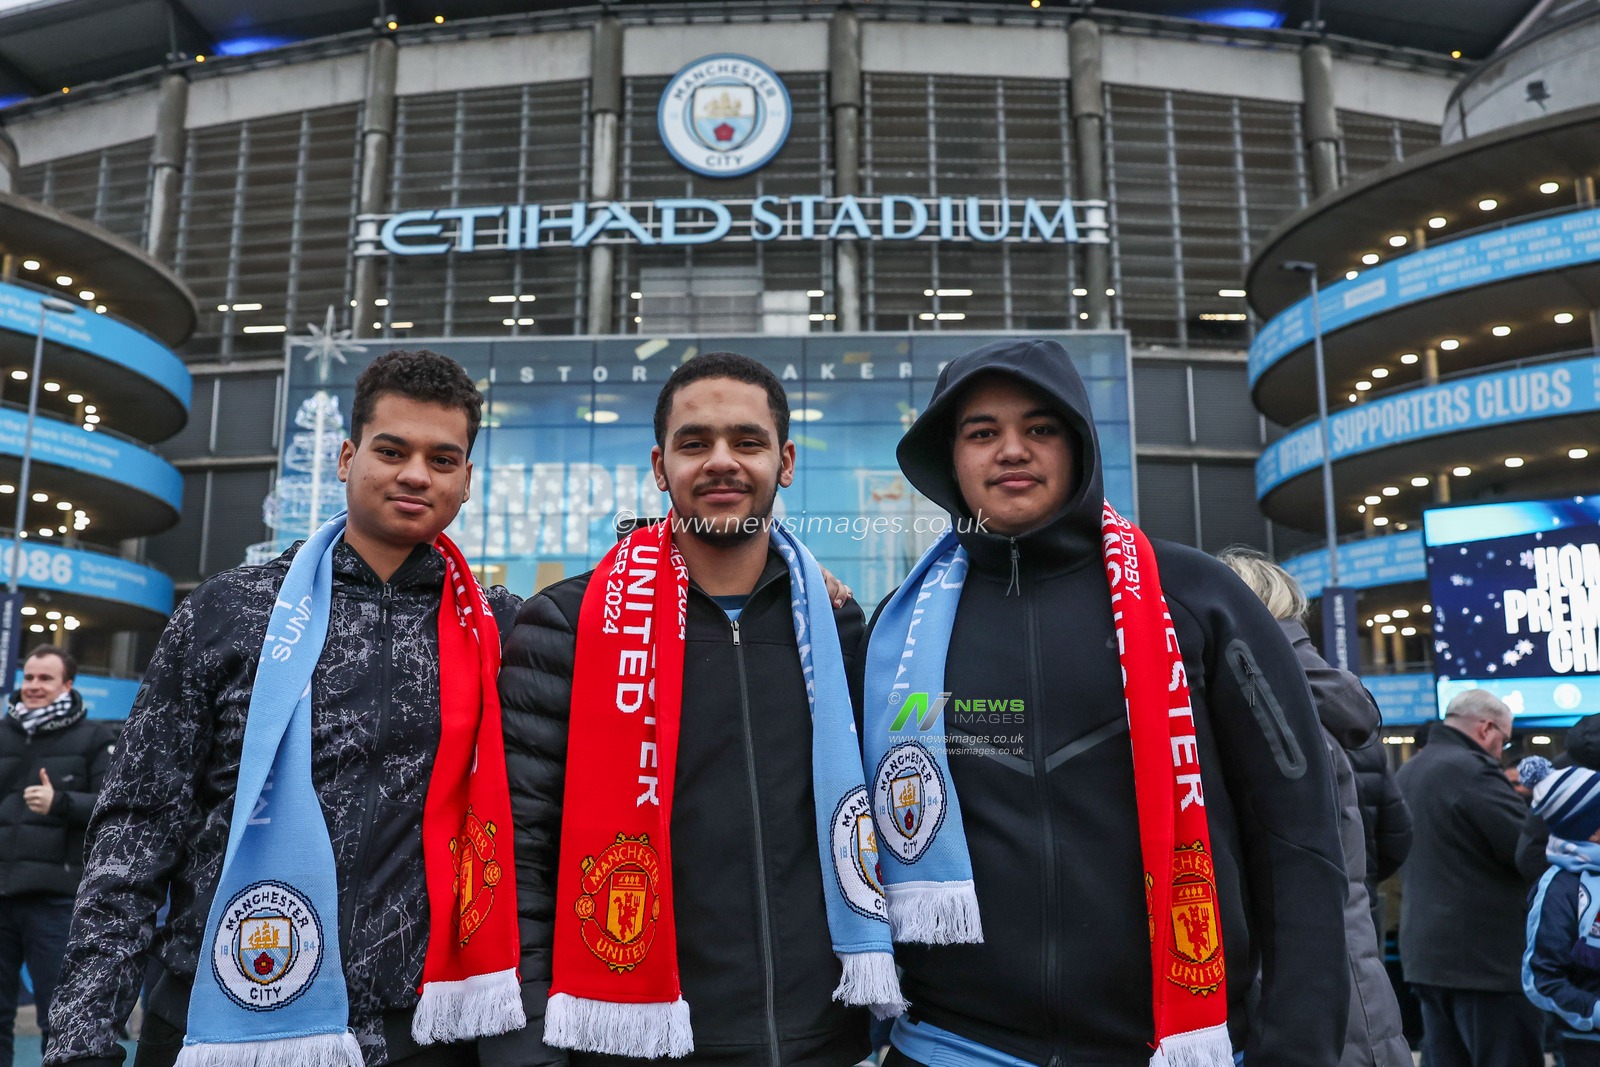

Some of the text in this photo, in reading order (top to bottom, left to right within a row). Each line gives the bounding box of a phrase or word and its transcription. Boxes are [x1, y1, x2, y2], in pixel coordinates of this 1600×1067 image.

[674, 64, 776, 101] MANCHESTER
[705, 155, 744, 167] CITY
[380, 195, 1080, 256] ETIHAD STADIUM
[489, 364, 678, 384] ISTOR
[1333, 387, 1472, 453] SUPPORTERS
[1475, 368, 1573, 421] CLUBS
[0, 545, 73, 585] 986
[1120, 529, 1142, 600] DERBY
[602, 579, 624, 634] 2024
[271, 594, 313, 663] SUND
[615, 545, 660, 714] UNITED
[880, 751, 932, 792] MANCHESTER
[590, 845, 659, 887] MANCHESTER
[903, 841, 918, 854] CITY
[226, 891, 309, 931] MANCHESTER
[597, 937, 645, 962] UNITED
[250, 986, 282, 1002] CITY
